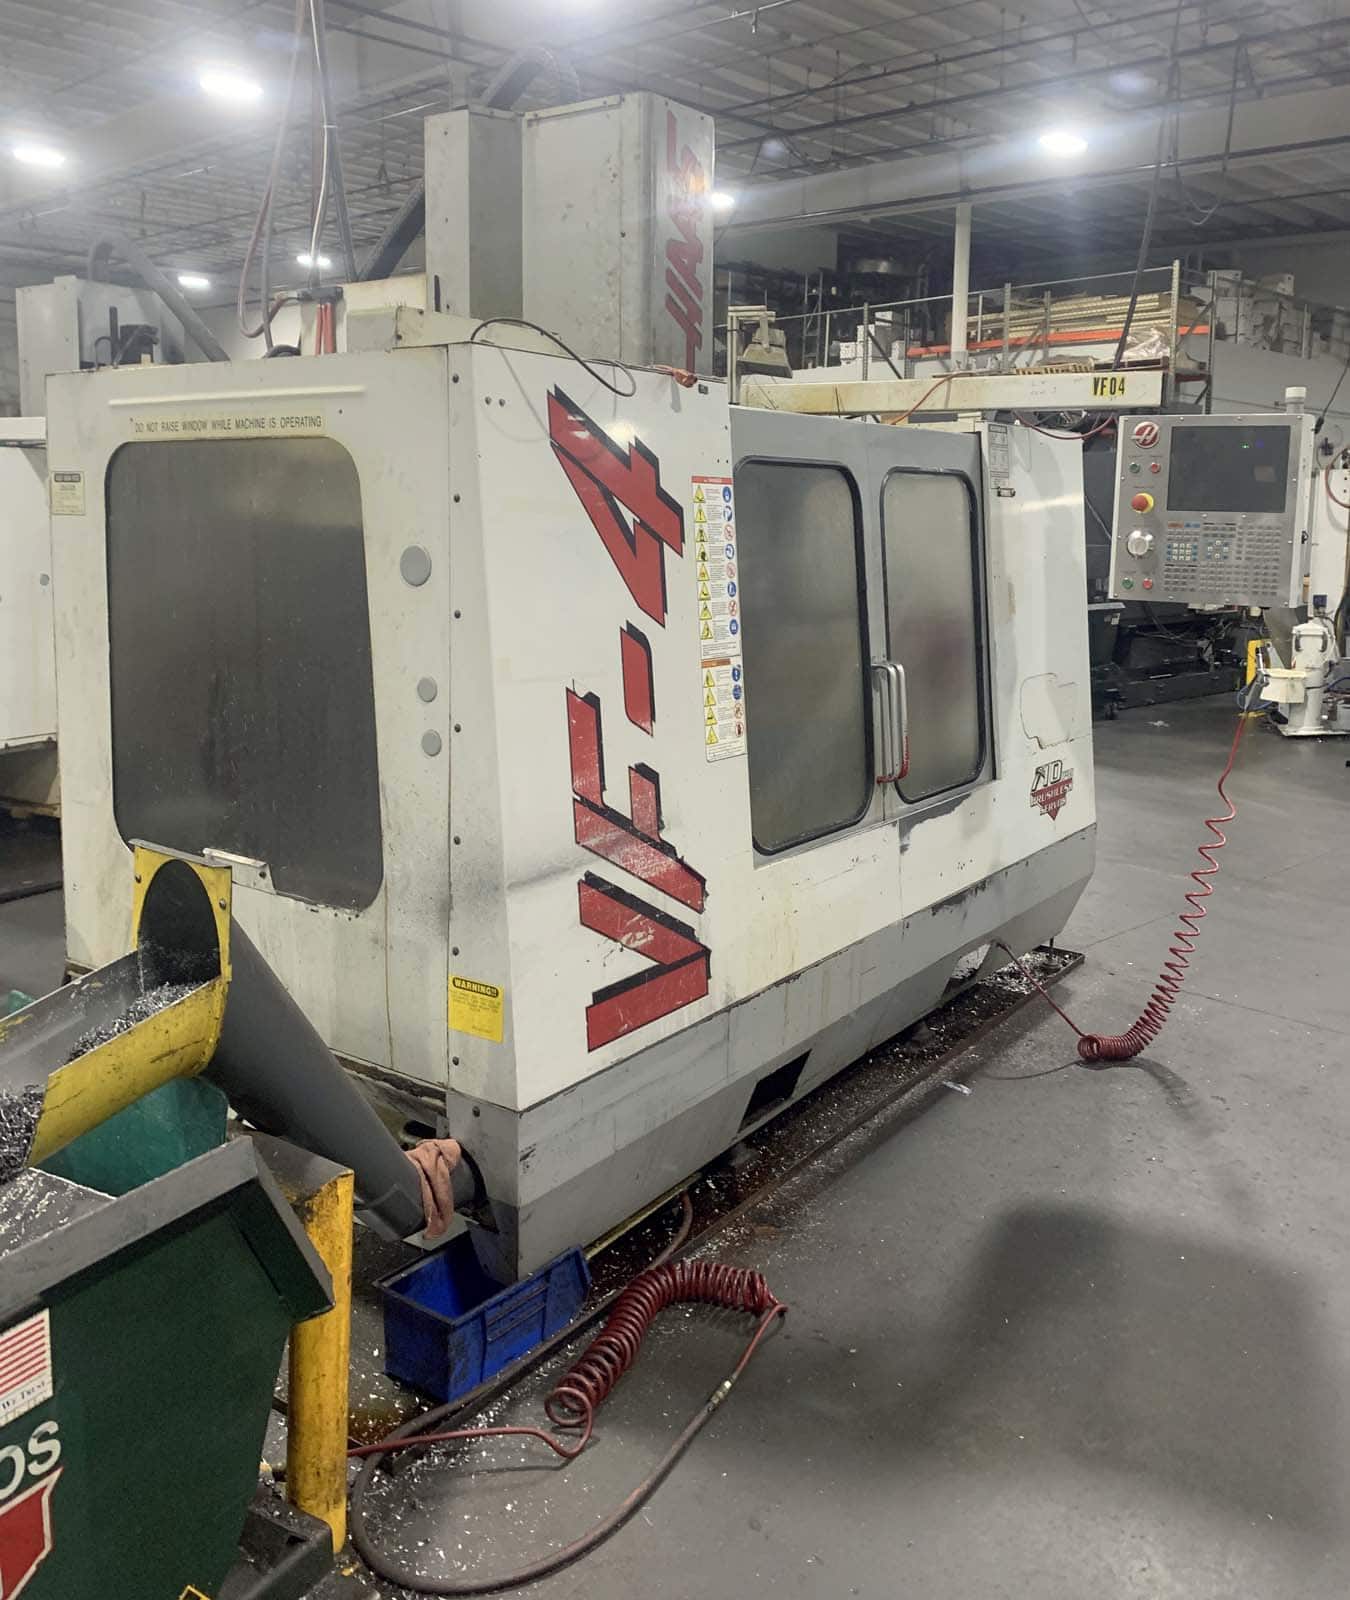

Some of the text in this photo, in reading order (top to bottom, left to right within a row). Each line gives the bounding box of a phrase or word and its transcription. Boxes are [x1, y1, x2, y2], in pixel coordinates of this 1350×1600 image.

[665, 110, 704, 372] HAAS
[135, 415, 322, 433] DO NOT RAISE WINDOW WHILE MACHINE IS OPERATING
[547, 384, 712, 1052] VF-4
